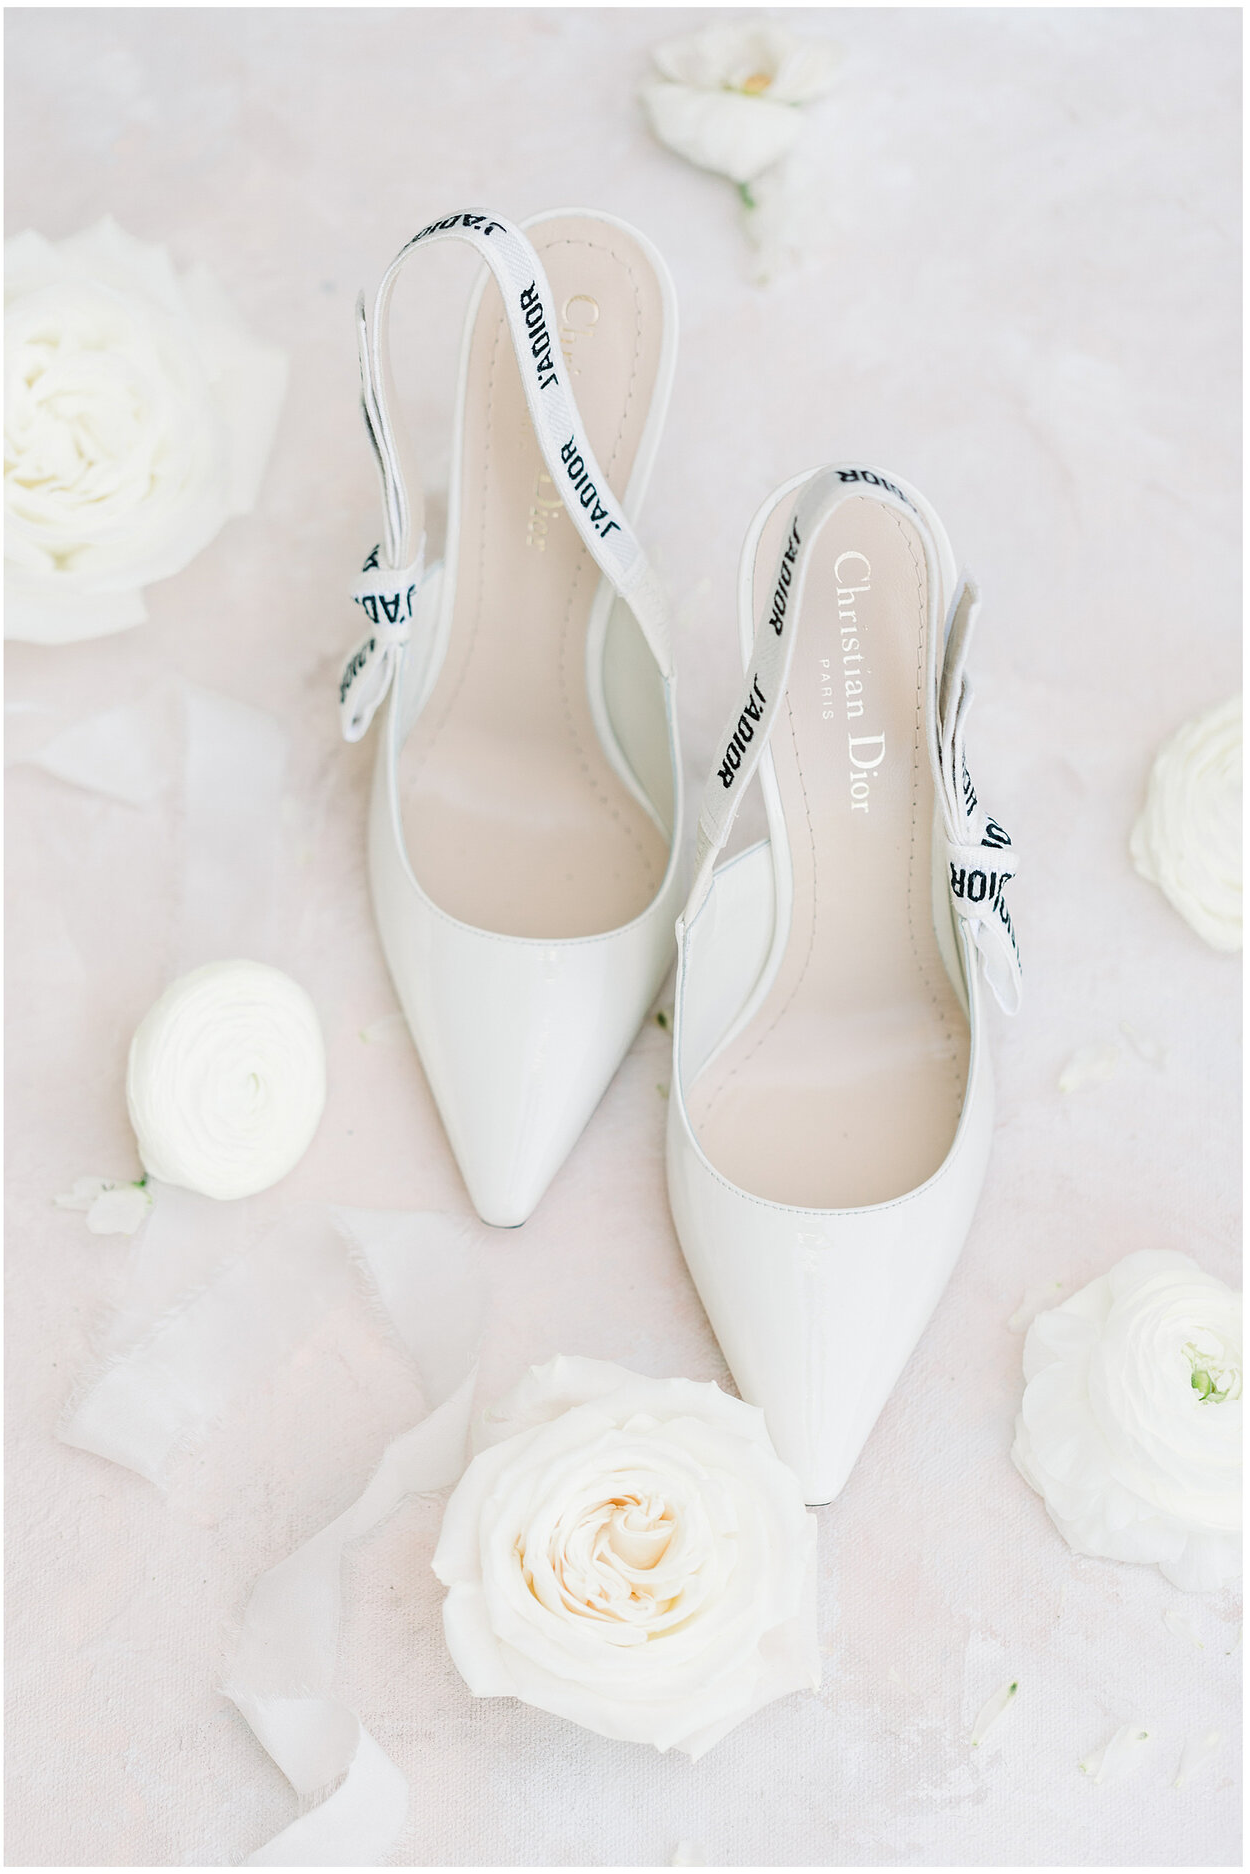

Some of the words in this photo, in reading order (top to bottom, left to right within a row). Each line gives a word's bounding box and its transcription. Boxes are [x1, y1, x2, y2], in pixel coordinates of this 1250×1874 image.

[520, 280, 559, 389] J'ADIOR
[561, 435, 621, 538] J'ADIOR
[769, 516, 801, 636] J'ADIOR
[818, 658, 834, 721] PARIS
[834, 550, 872, 720] Christian
[717, 672, 767, 789] J'ADIOR
[849, 730, 886, 814] Dior
